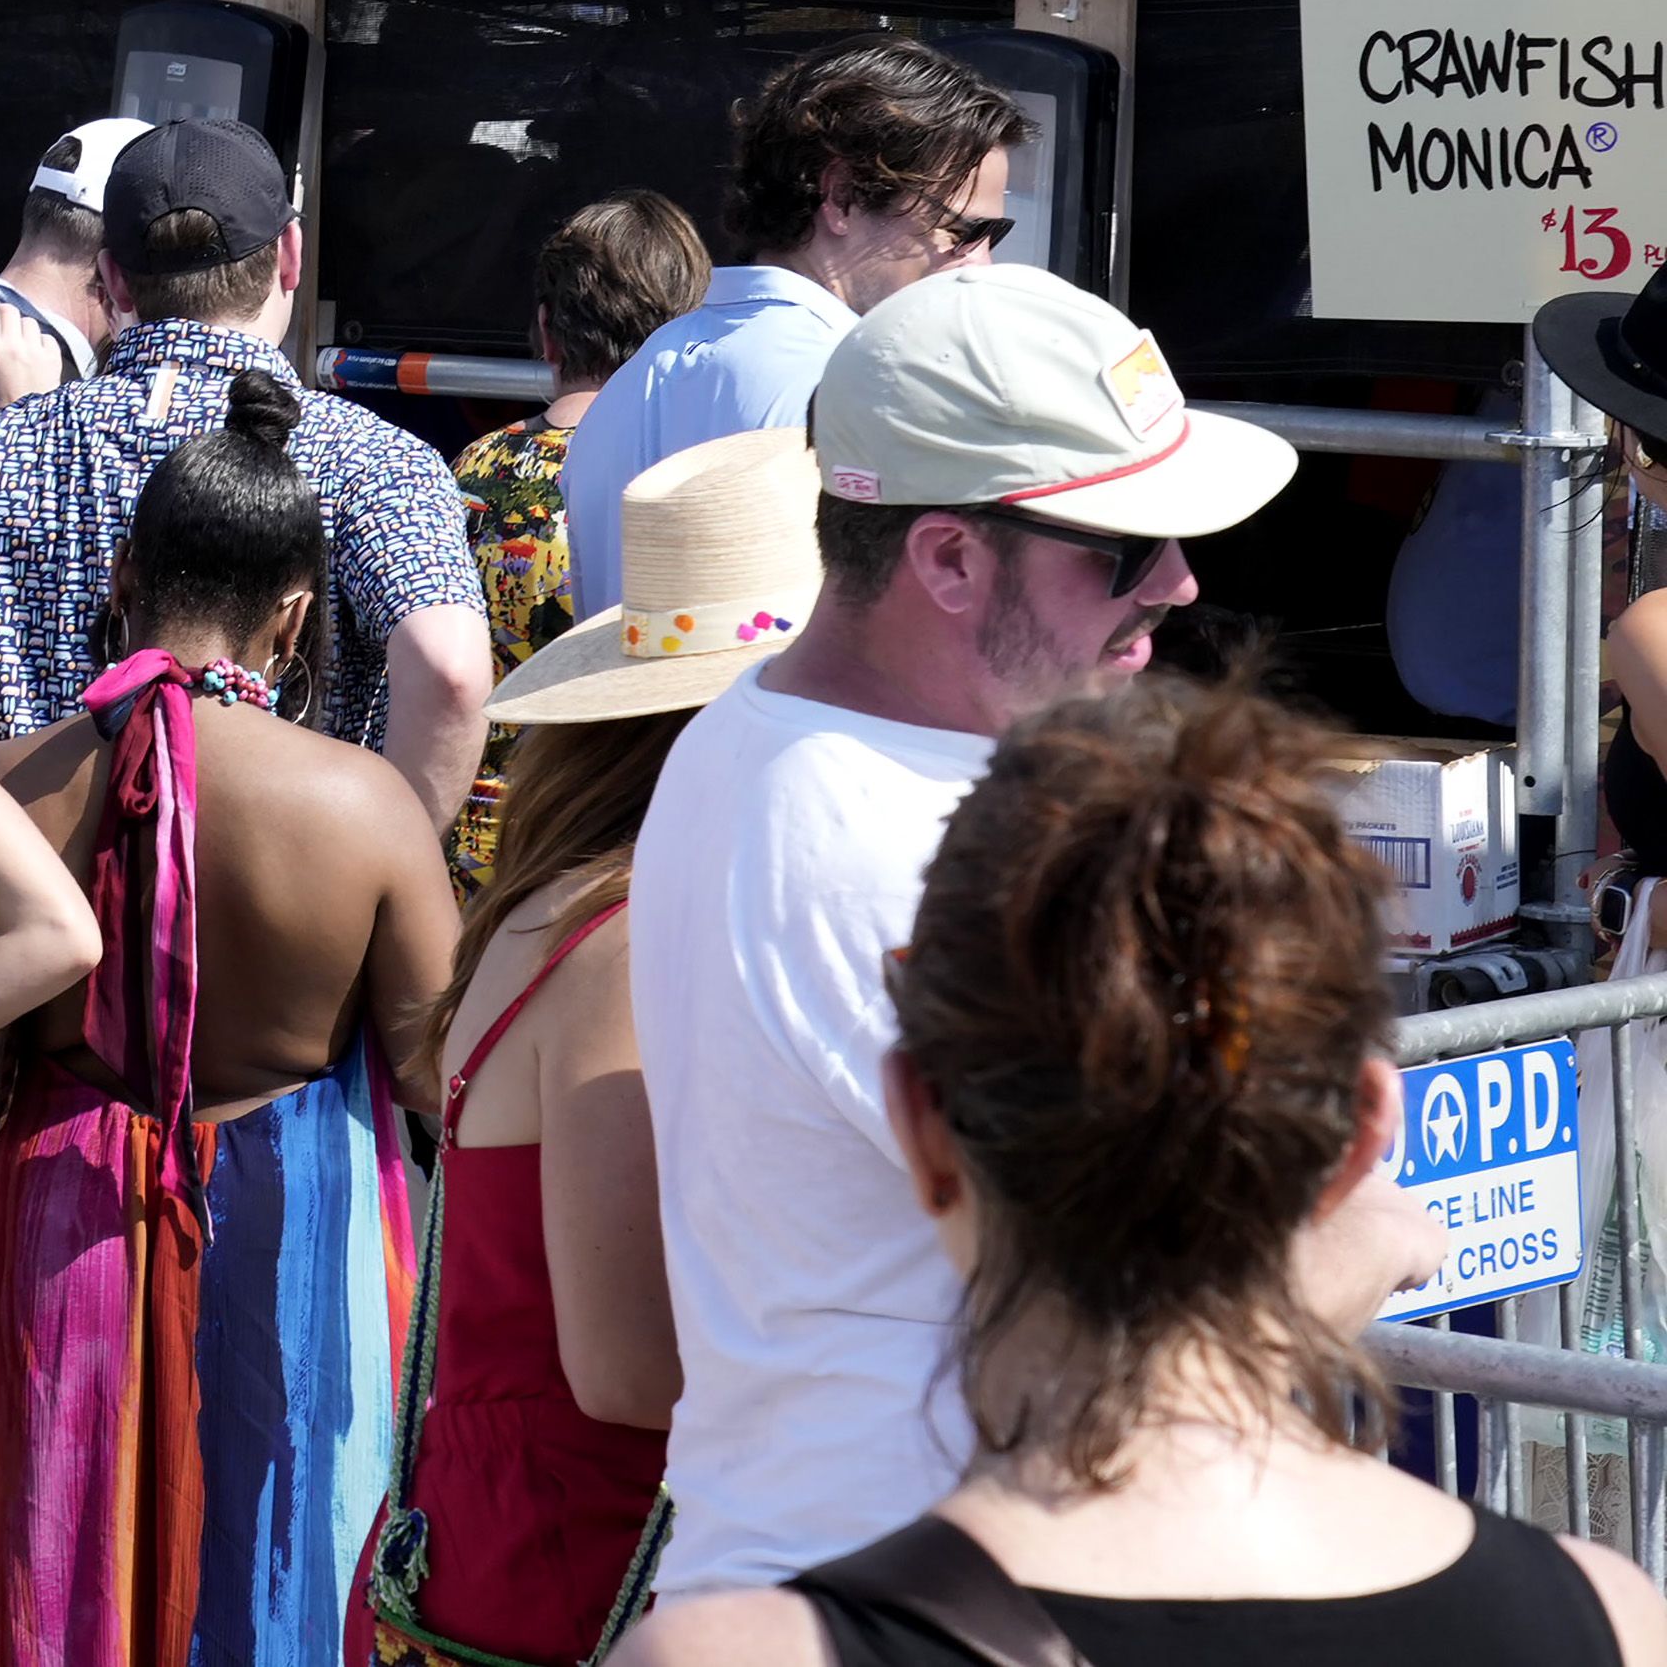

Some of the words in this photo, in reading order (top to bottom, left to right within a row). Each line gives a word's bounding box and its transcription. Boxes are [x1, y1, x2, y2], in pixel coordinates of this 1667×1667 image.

[1359, 28, 1664, 109] CRAWFISH
[1541, 205, 1631, 280] $13
[1474, 1179, 1535, 1223] LINE
[1458, 1228, 1558, 1280] CROSS
